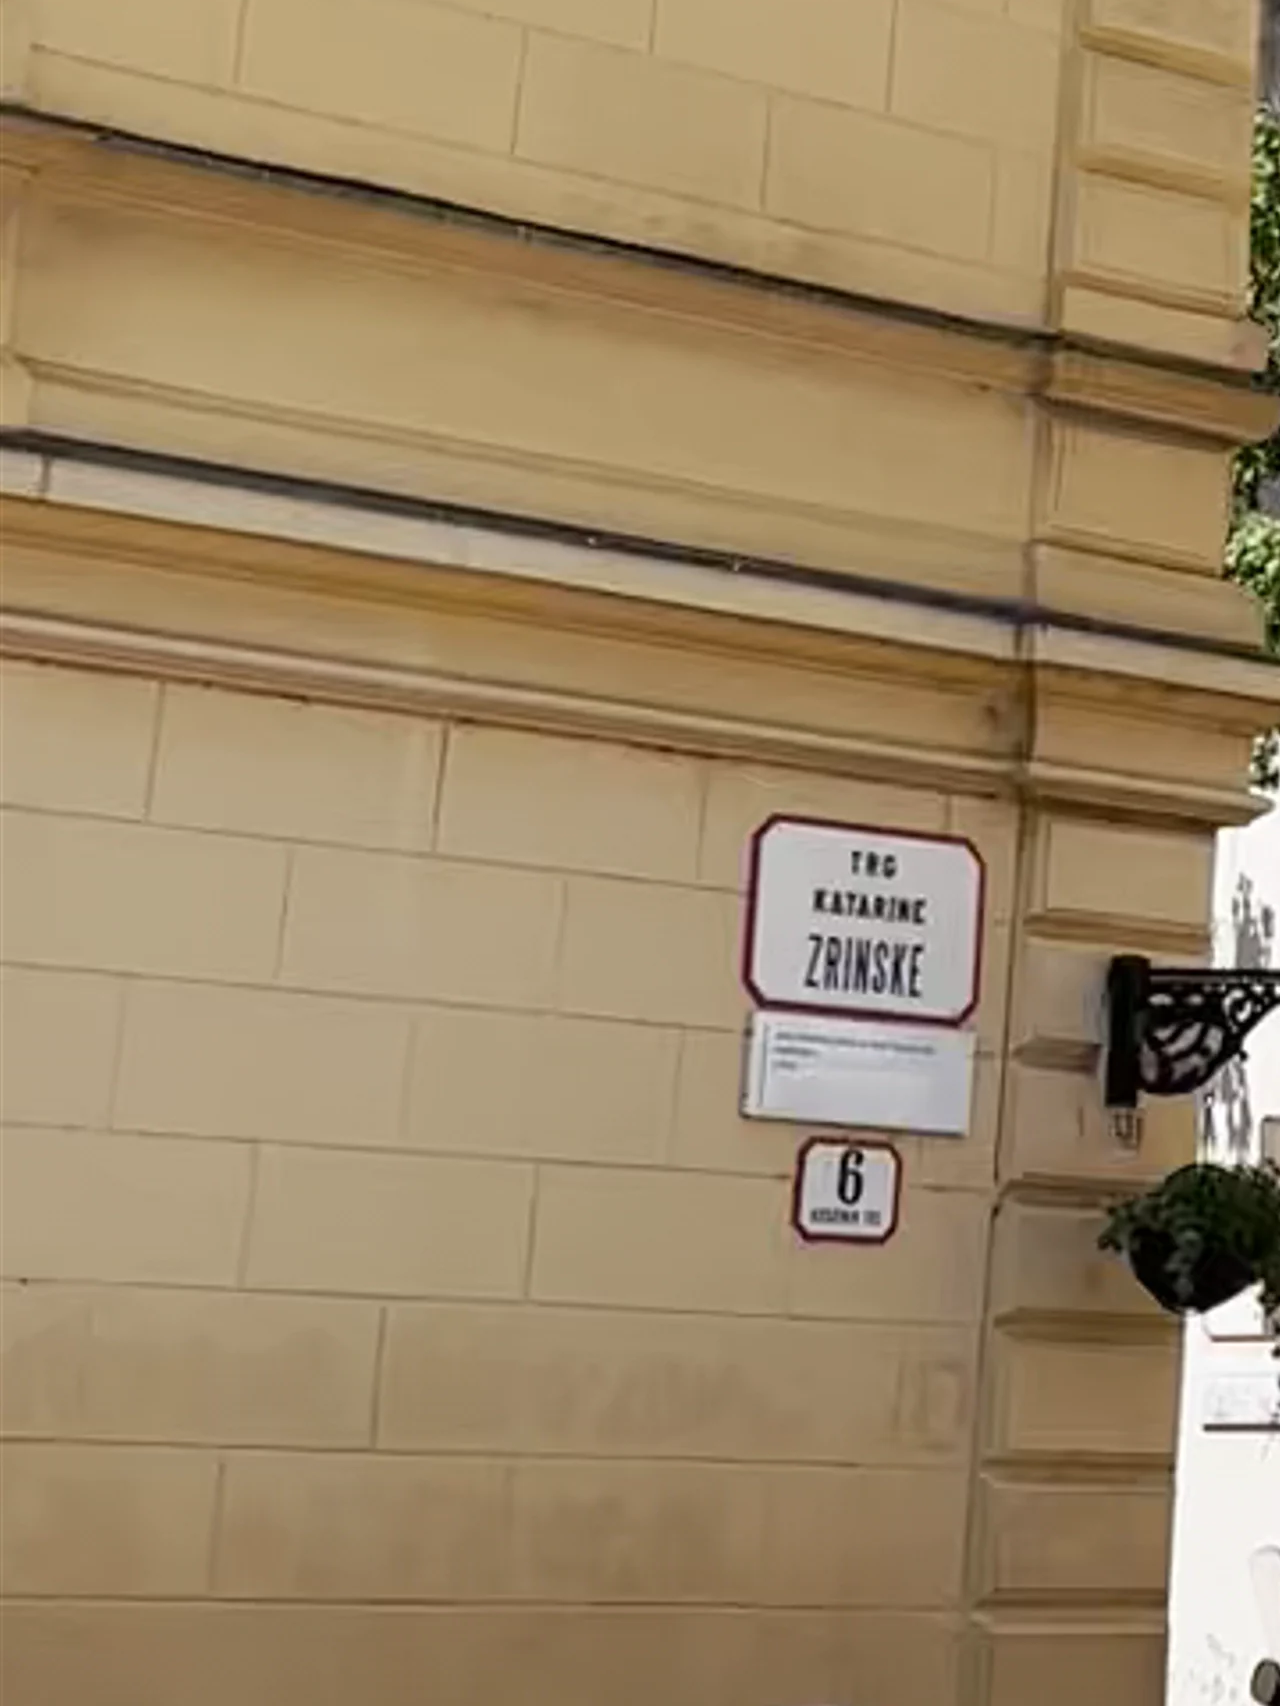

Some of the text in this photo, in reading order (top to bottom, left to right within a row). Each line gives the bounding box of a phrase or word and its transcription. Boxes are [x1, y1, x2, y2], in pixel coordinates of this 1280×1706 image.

[850, 850, 898, 880] TRG
[812, 888, 928, 927] KATARINE
[803, 933, 925, 1000] ZRINSKE
[837, 1148, 864, 1206] 6
